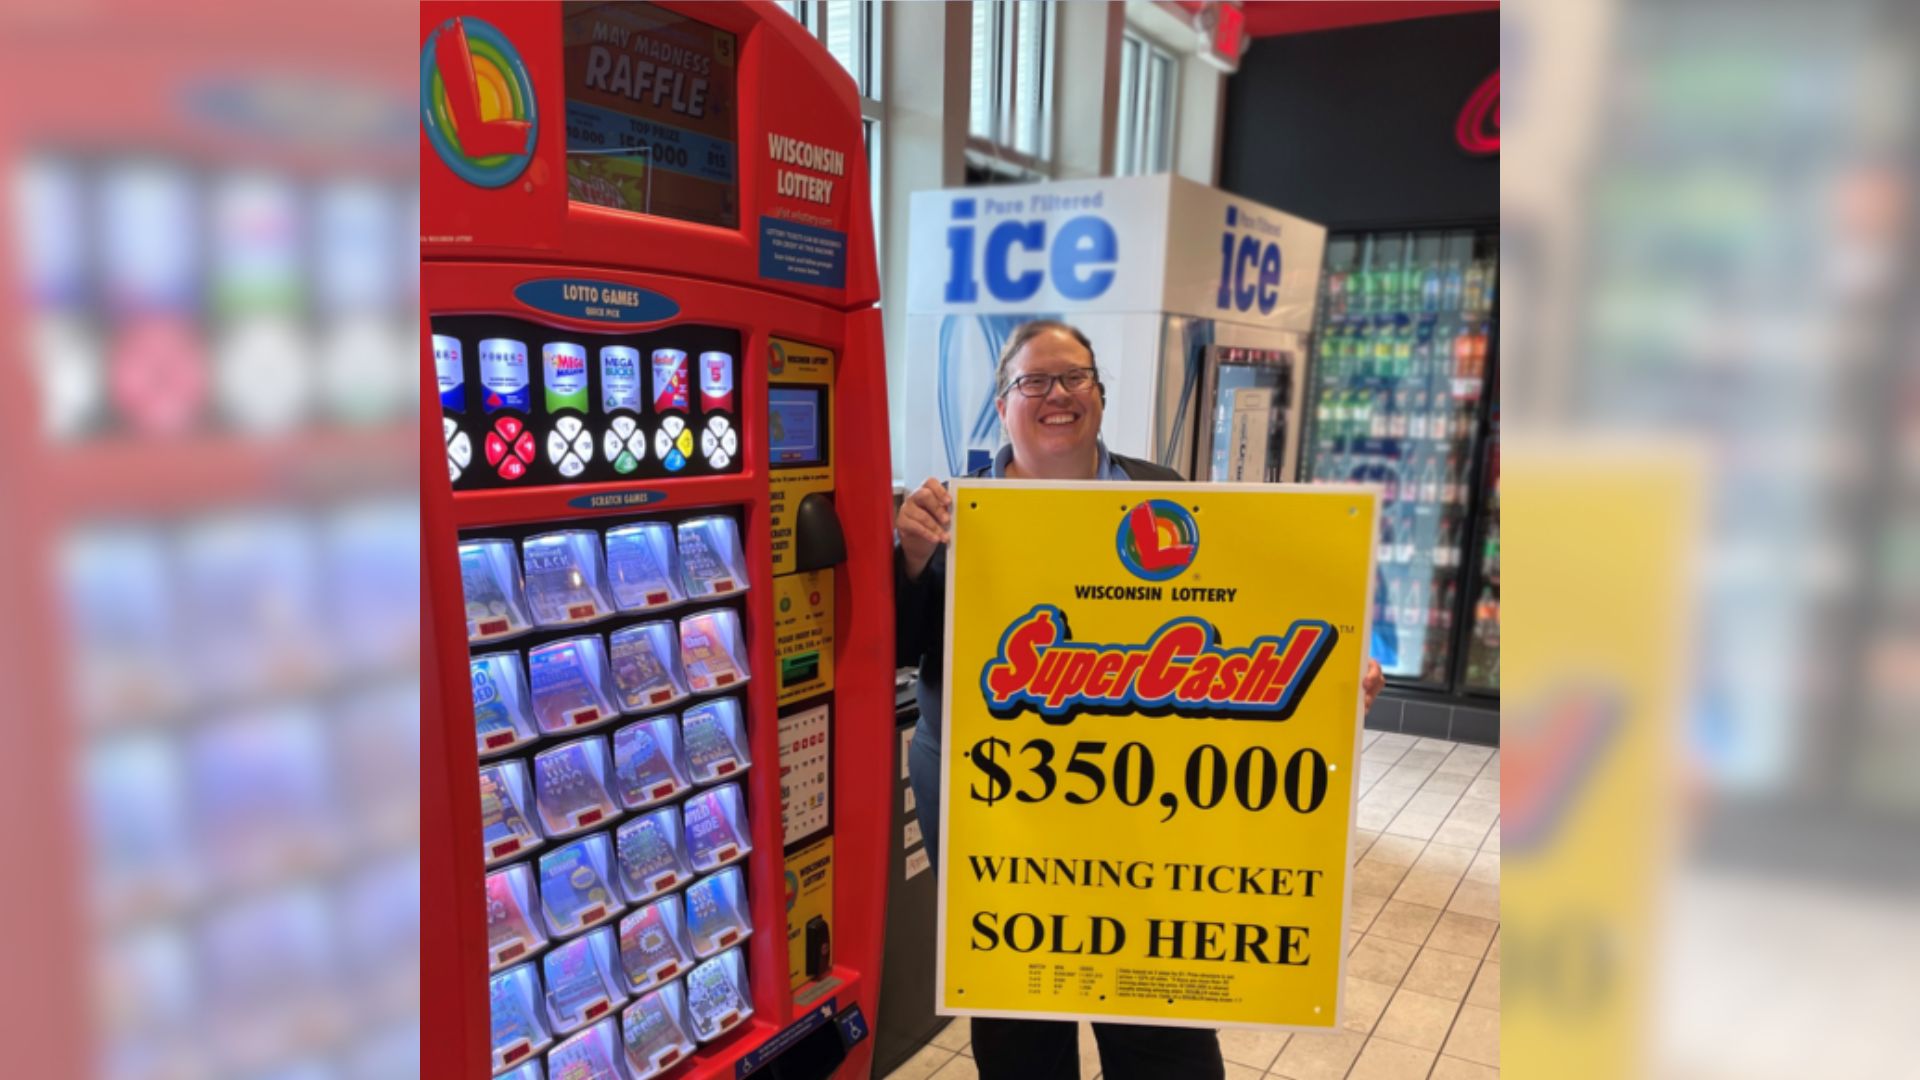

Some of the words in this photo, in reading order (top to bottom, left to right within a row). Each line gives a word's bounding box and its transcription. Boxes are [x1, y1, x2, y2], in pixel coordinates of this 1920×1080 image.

[593, 21, 630, 48] MAY
[634, 35, 711, 75] MADNESS
[586, 46, 708, 118] RAFFLE
[629, 119, 650, 134] TOP
[652, 124, 680, 143] PRIZE
[768, 132, 844, 176] WISCONSIN
[777, 169, 833, 204] LOTTERY
[985, 199, 1024, 215] Pure
[1031, 191, 1103, 213] Filtered
[944, 197, 1119, 304] ice
[1217, 204, 1282, 316] ice
[563, 283, 598, 303] LOTTO
[601, 288, 640, 307] GAMES
[556, 352, 584, 369] MEGA
[605, 357, 634, 368] MEGA
[592, 495, 622, 507] SCRATCH
[623, 493, 648, 505] GAMES
[1074, 584, 1163, 601] WISCONSIN
[1171, 587, 1238, 603] LOTTERY
[969, 736, 1329, 823] $350,000
[968, 855, 1154, 890] WINNING
[1164, 862, 1324, 898] TICKET
[970, 910, 1127, 956] SOLD
[1144, 918, 1312, 967] HERE
